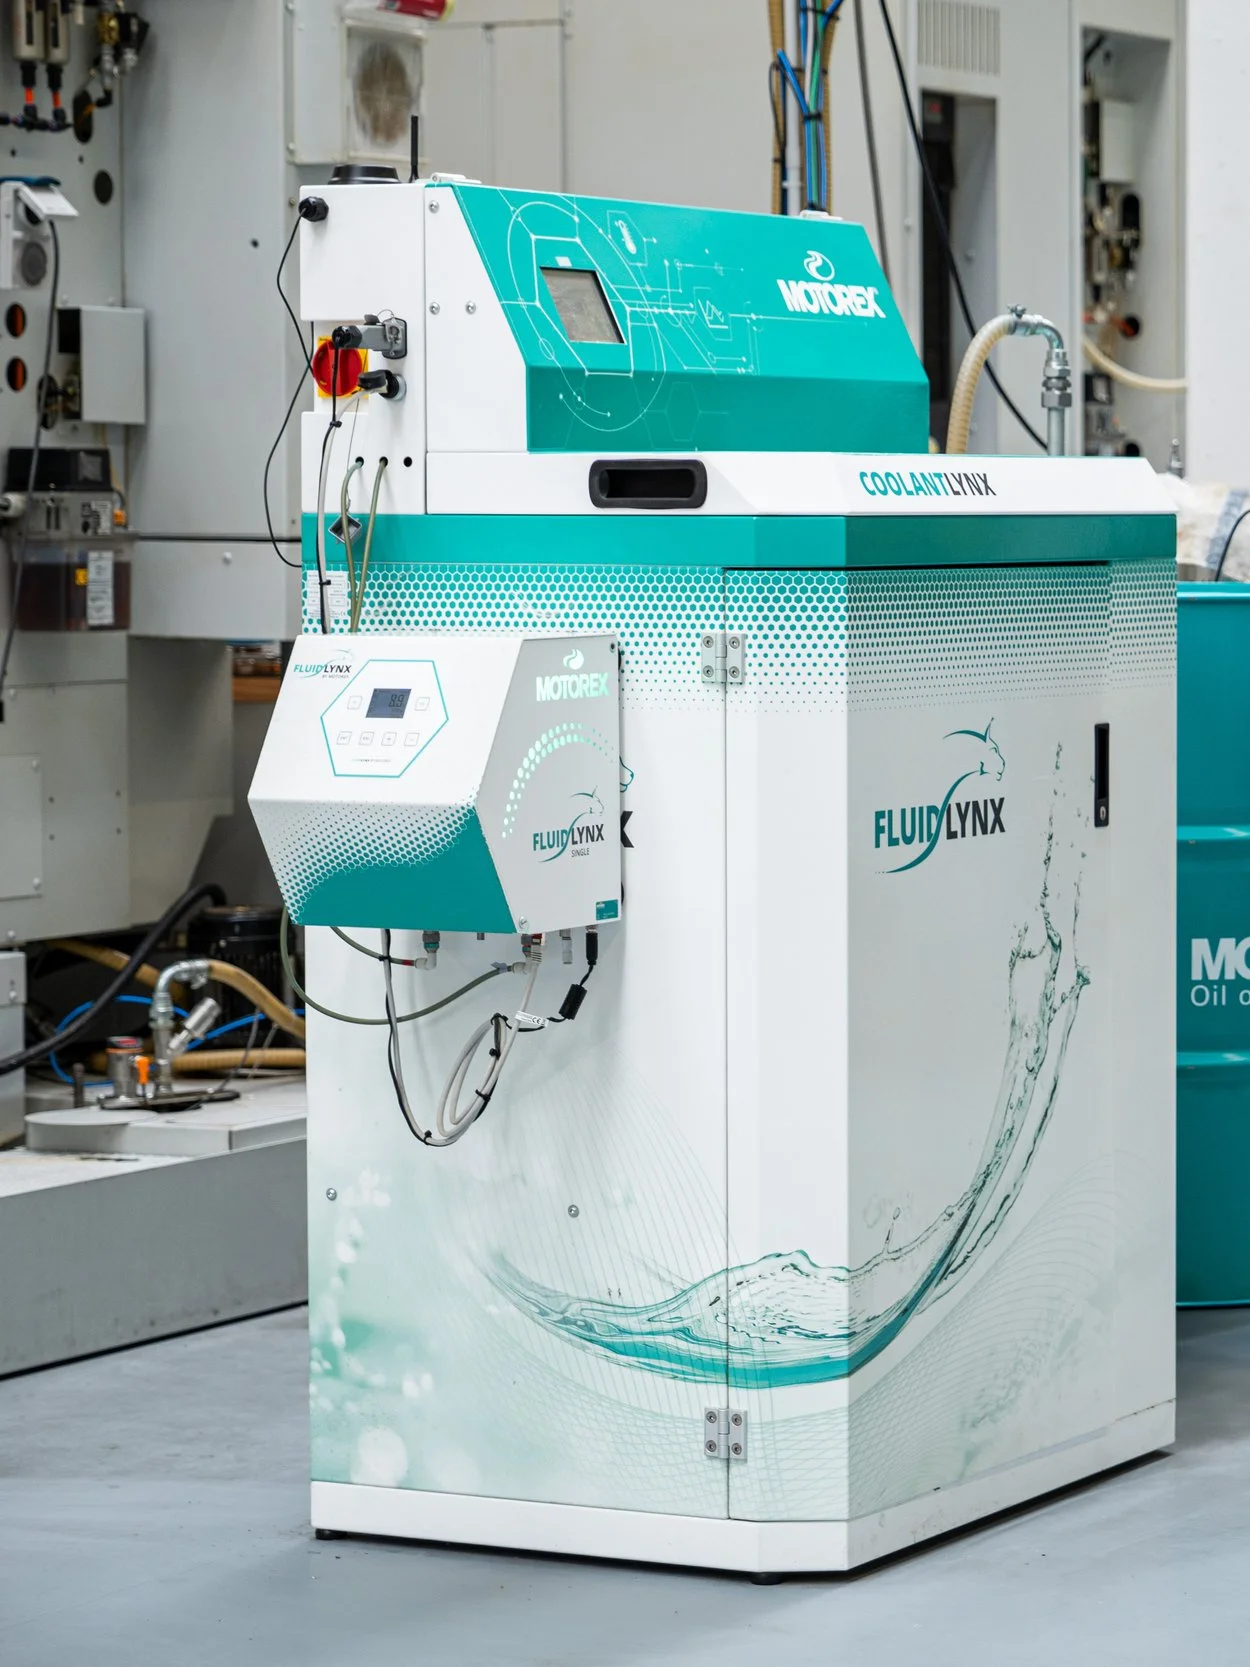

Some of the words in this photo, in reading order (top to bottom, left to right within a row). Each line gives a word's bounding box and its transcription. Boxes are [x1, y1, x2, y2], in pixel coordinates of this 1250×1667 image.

[776, 279, 887, 319] MOTOREX
[859, 471, 997, 496] COOLANTLYNX
[535, 671, 611, 702] MOTOREX
[873, 796, 1006, 849] FLUIDLYNX
[571, 847, 590, 858] SINGLE
[1190, 984, 1226, 1007] Oil
